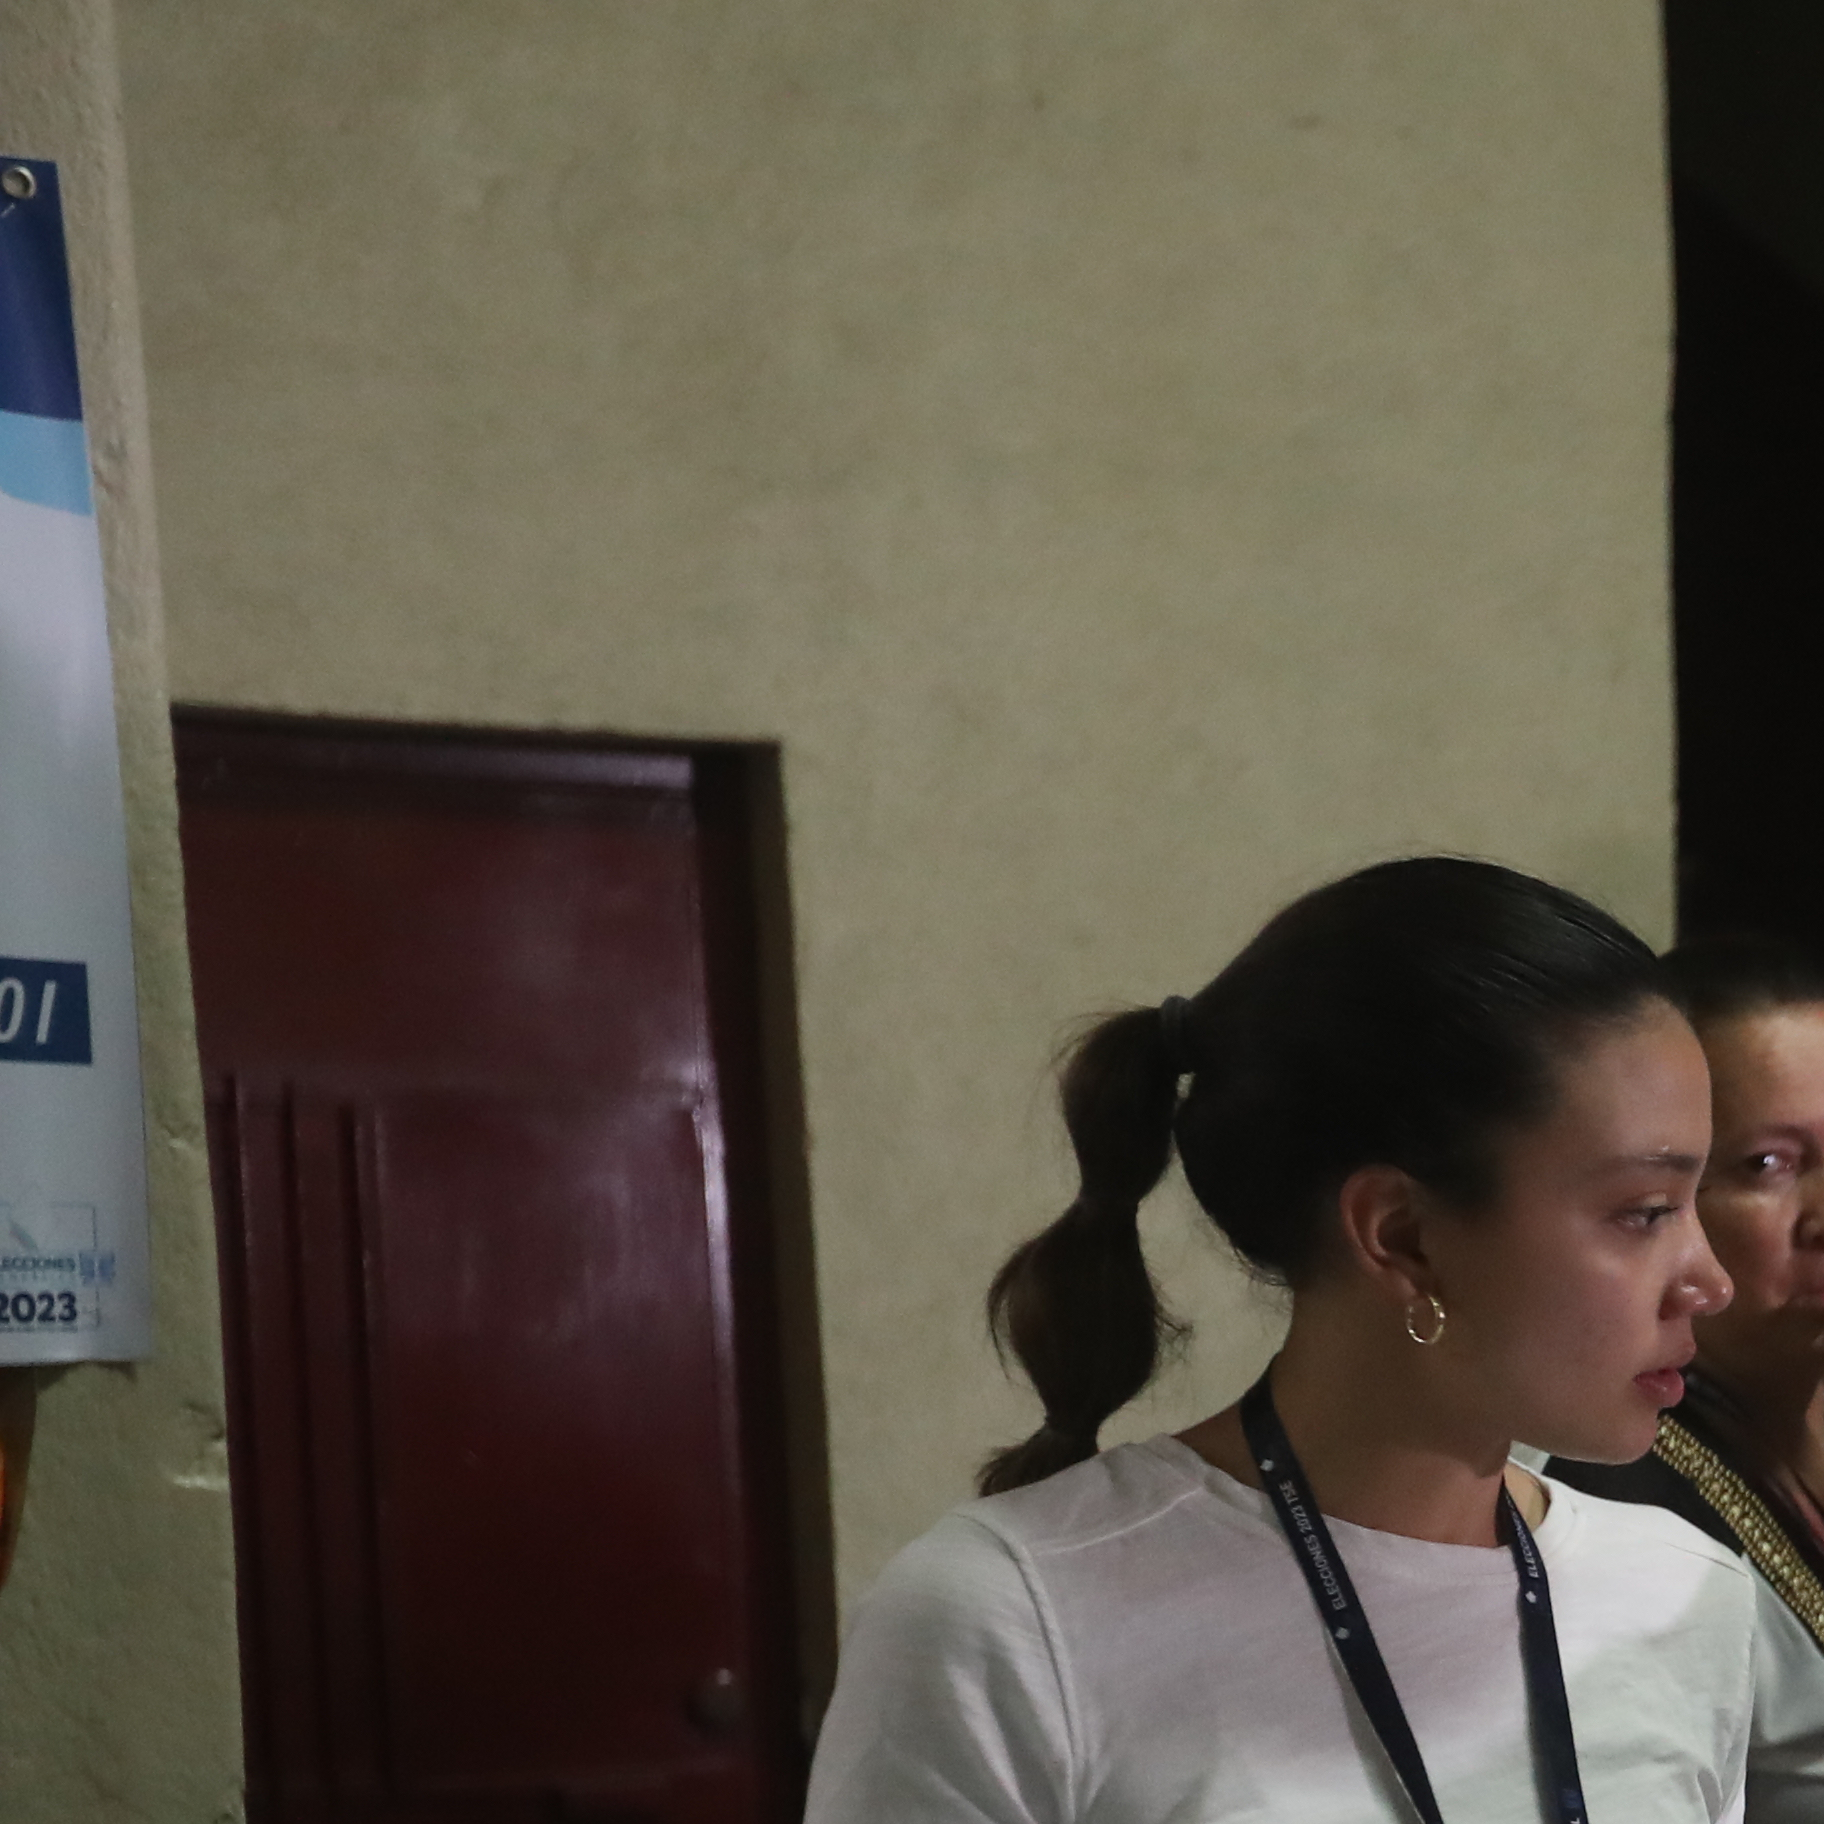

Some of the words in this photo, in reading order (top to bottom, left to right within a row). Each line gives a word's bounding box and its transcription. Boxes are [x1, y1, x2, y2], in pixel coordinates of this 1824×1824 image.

[0, 1292, 77, 1323] 2023
[1280, 1480, 1298, 1505] TSE
[1290, 1504, 1313, 1533] 2023
[1303, 1533, 1347, 1611] ELECCIONES
